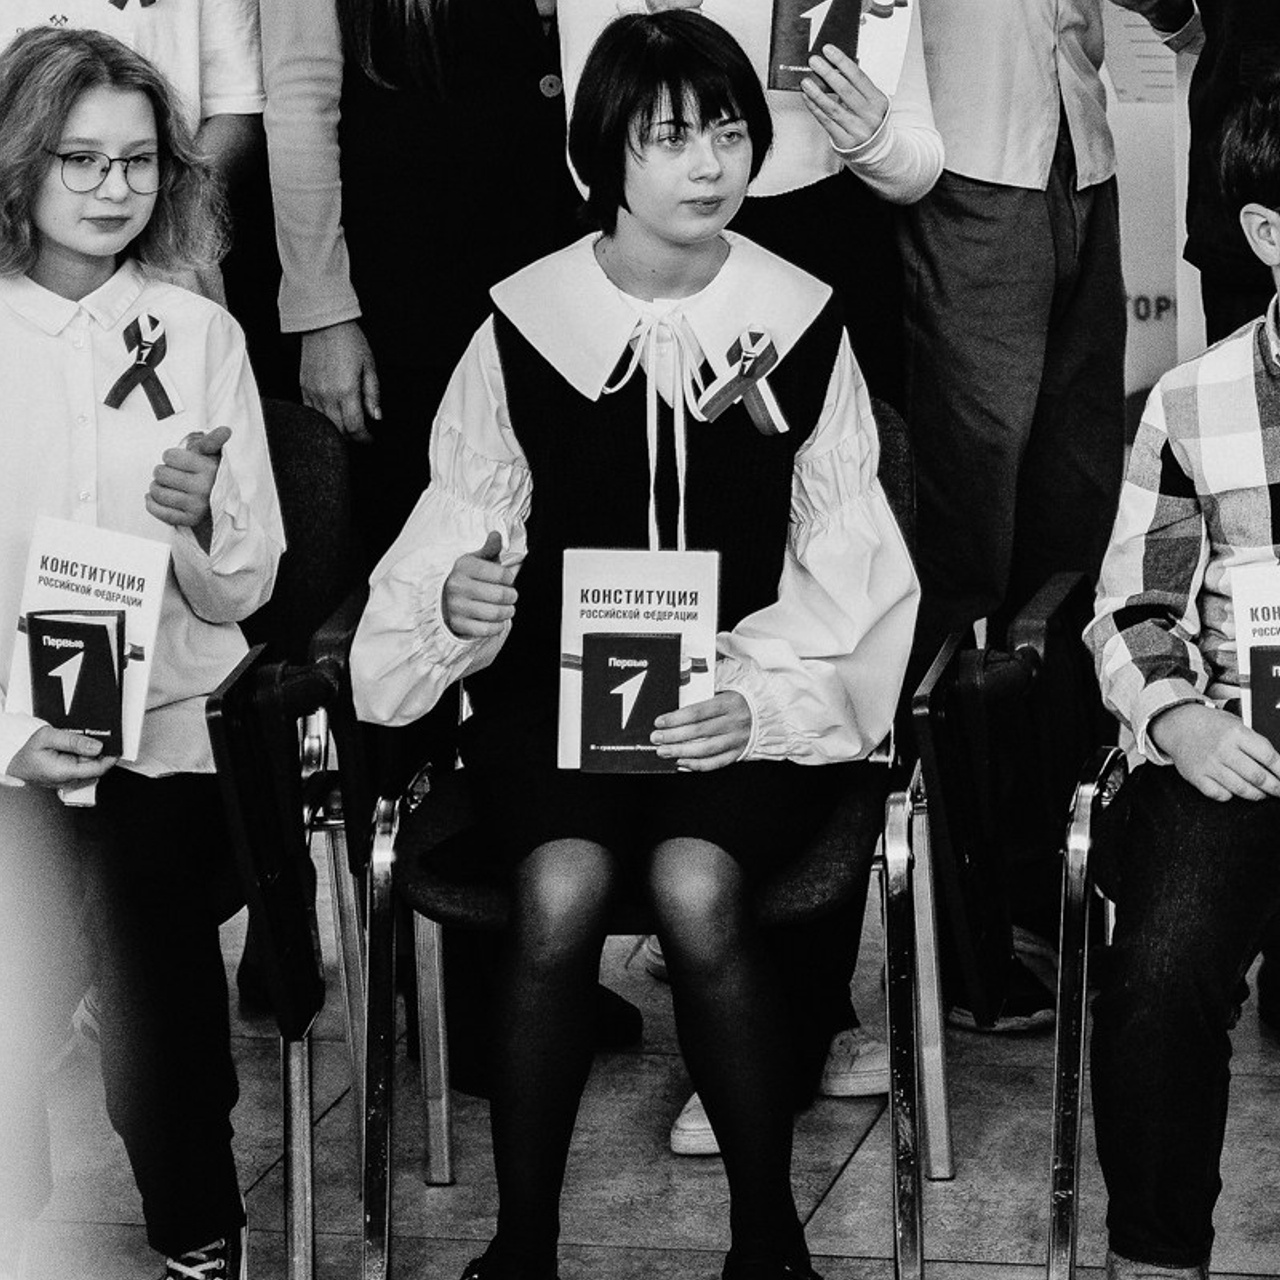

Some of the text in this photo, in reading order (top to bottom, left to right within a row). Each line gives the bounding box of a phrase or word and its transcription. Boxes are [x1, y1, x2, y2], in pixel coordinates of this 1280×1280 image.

[39, 555, 146, 594] КОНСТИТУЦИЯ
[38, 576, 143, 608] РОССИЙСКОЙ ФЕДЕРАЦИИ
[580, 588, 699, 608] КОНСТИТУЦИЯ
[579, 607, 699, 623] РОССИЙСКОЙ ФЕДЕРАЦИИ
[42, 635, 84, 650] Первые
[607, 656, 649, 670] Первые
